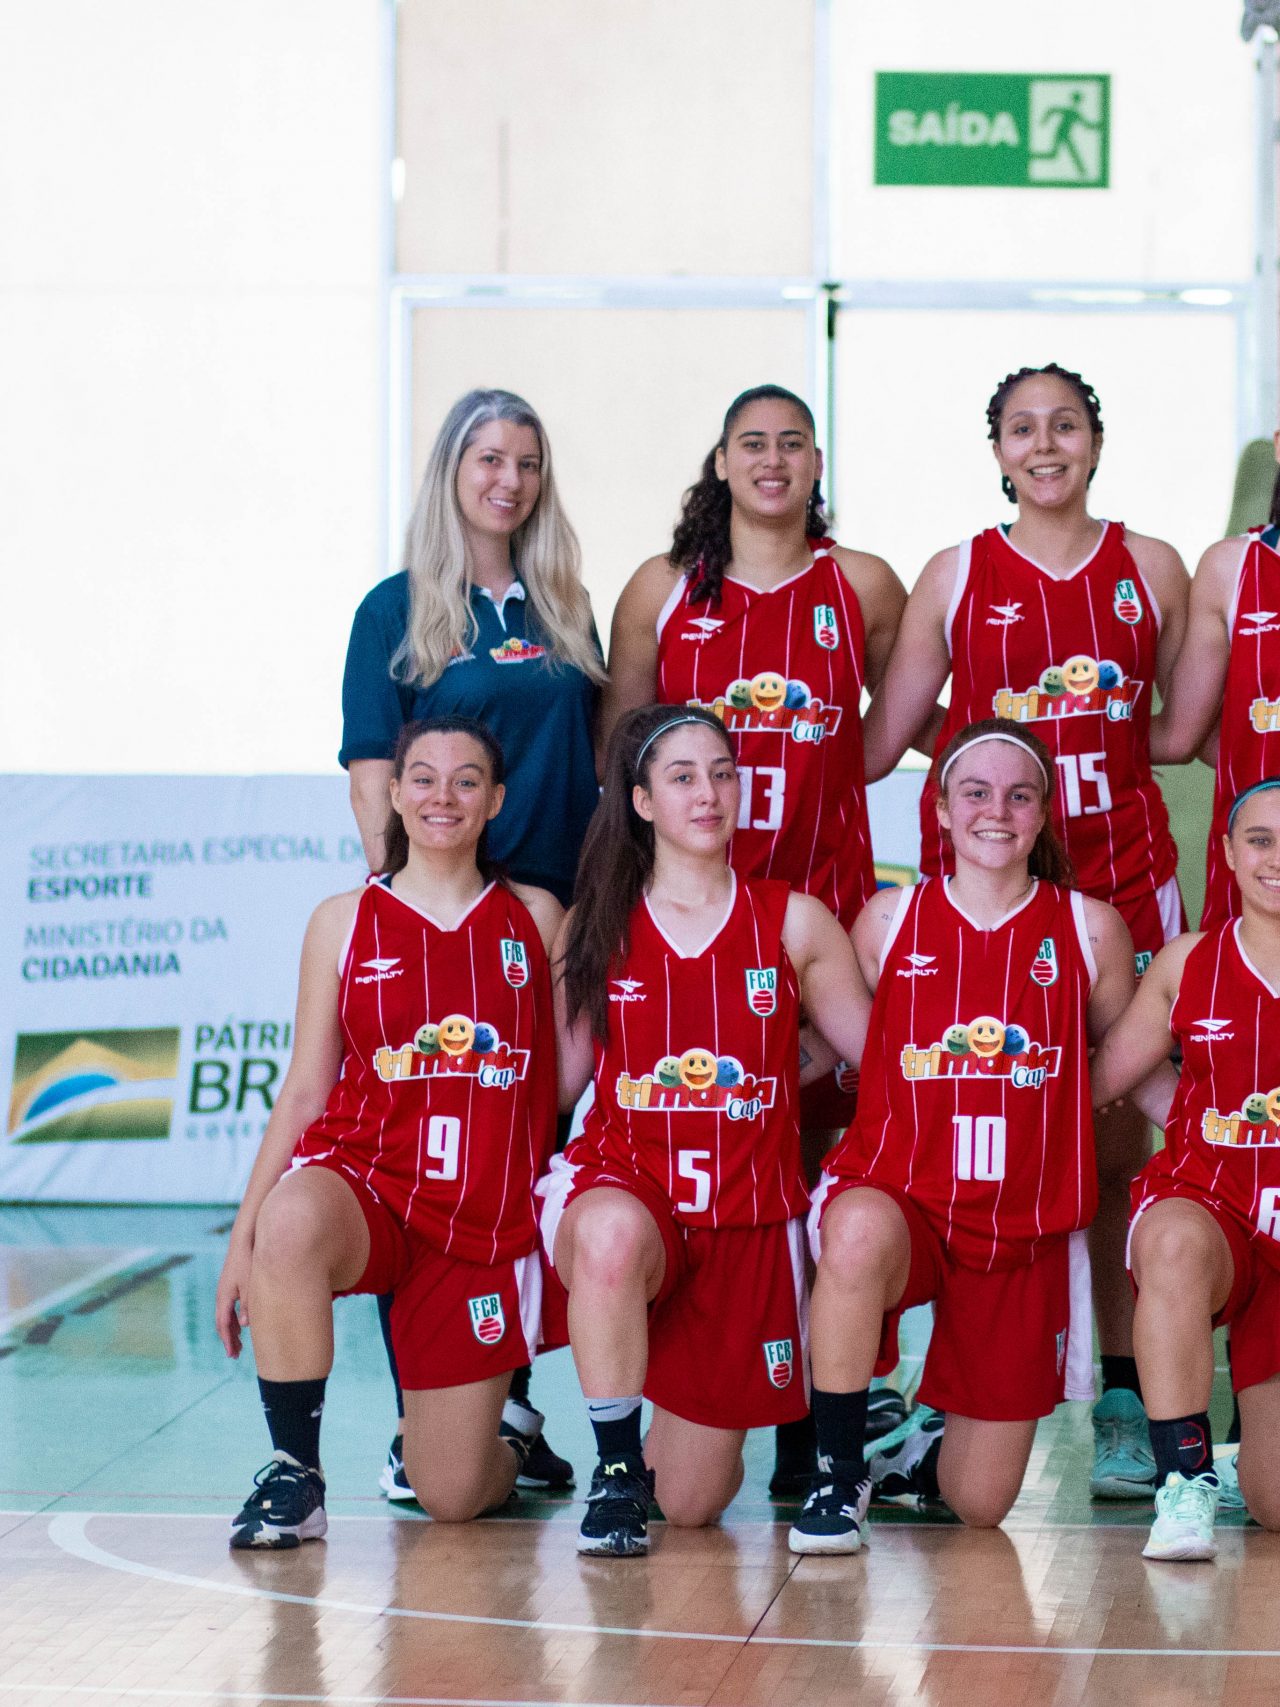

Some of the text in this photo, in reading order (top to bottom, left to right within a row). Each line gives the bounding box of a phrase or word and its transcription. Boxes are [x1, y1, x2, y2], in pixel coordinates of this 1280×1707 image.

[888, 100, 1019, 147] SAÍDA
[736, 766, 786, 829] 13
[1055, 752, 1112, 817] 15
[30, 840, 194, 871] SECRETARIA
[202, 834, 326, 864] ESPECIAL
[27, 872, 152, 901] ESPORTE
[24, 917, 228, 948] MINISTÉRIO DA
[21, 952, 181, 982] CIDADANIA
[355, 969, 404, 984] PENALTY
[749, 970, 774, 989] FCB
[609, 993, 647, 1002] ENALTY
[195, 1013, 292, 1051] PÁTRI
[1190, 1033, 1234, 1043] PENALTY
[375, 1045, 529, 1088] trimania Cap
[903, 1045, 1060, 1087] trimania Cap
[188, 1058, 279, 1114] BR
[618, 1074, 775, 1119] trimania Cap
[425, 1115, 460, 1180] 9
[952, 1115, 1006, 1181] 10
[678, 1150, 710, 1212] 5
[472, 1297, 499, 1319] FCB
[768, 1343, 791, 1364] FCB
